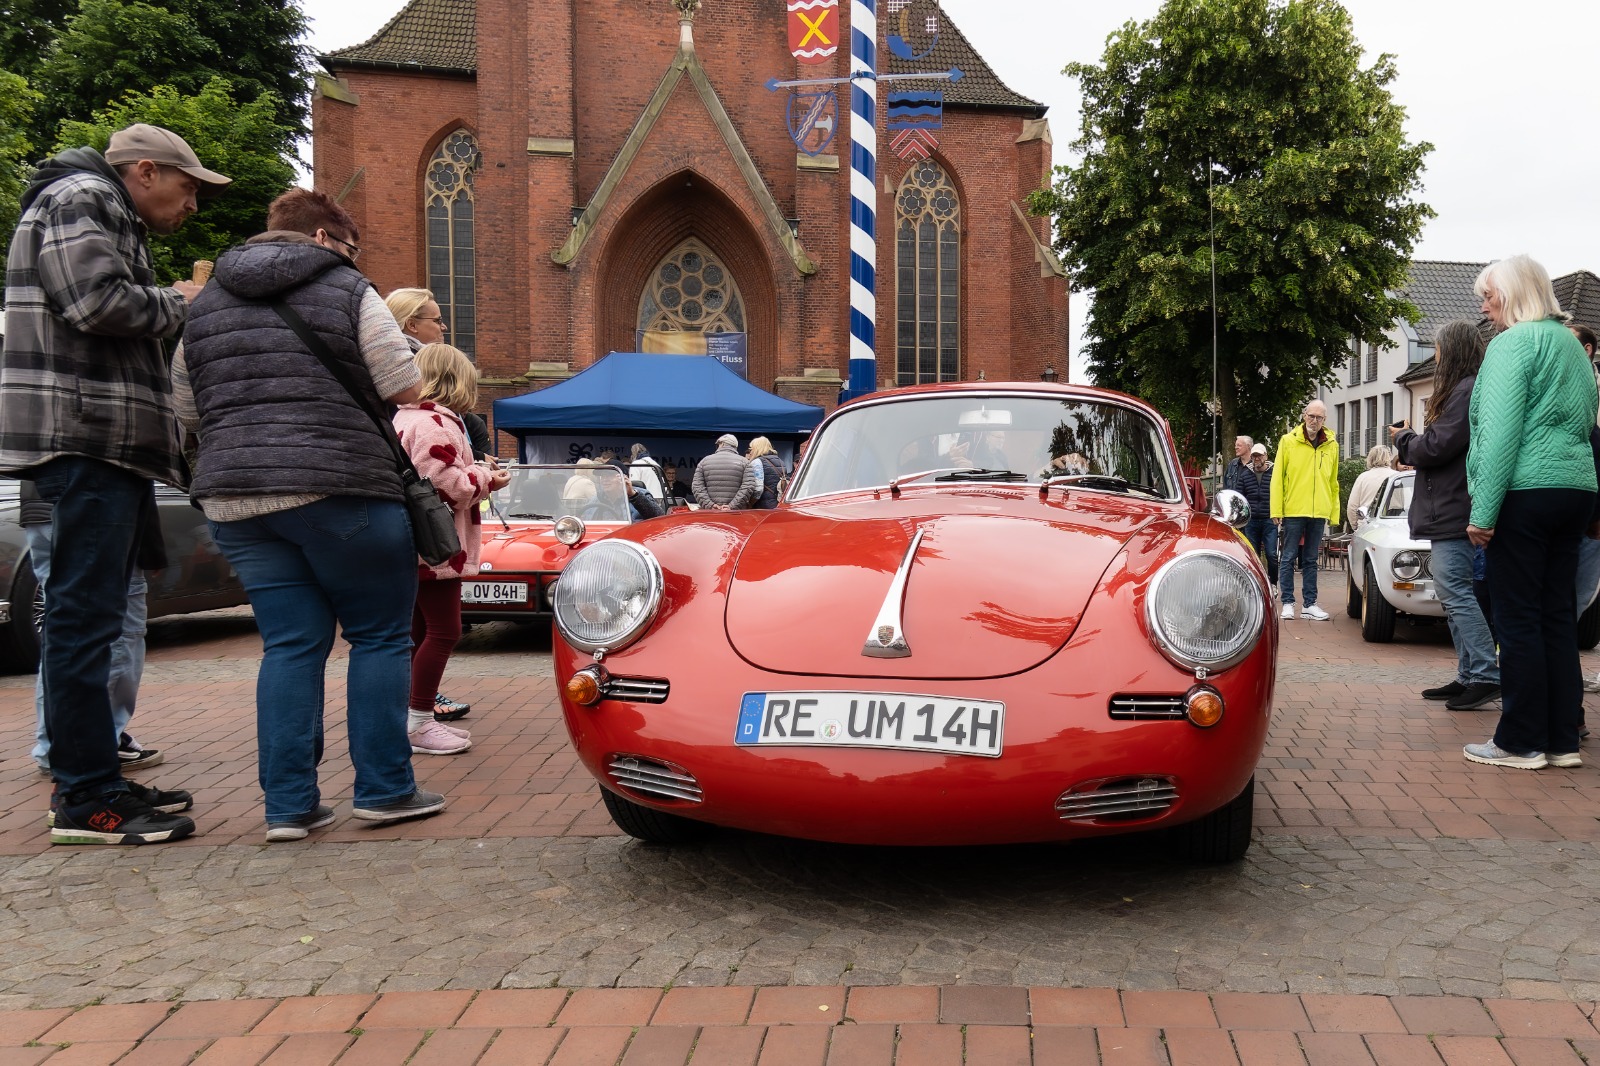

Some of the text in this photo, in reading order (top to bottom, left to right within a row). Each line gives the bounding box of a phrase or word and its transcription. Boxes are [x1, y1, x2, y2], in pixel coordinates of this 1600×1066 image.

[721, 355, 743, 363] Fluss
[473, 584, 518, 599] OV 84H
[743, 699, 999, 748] D RE UM 14H
